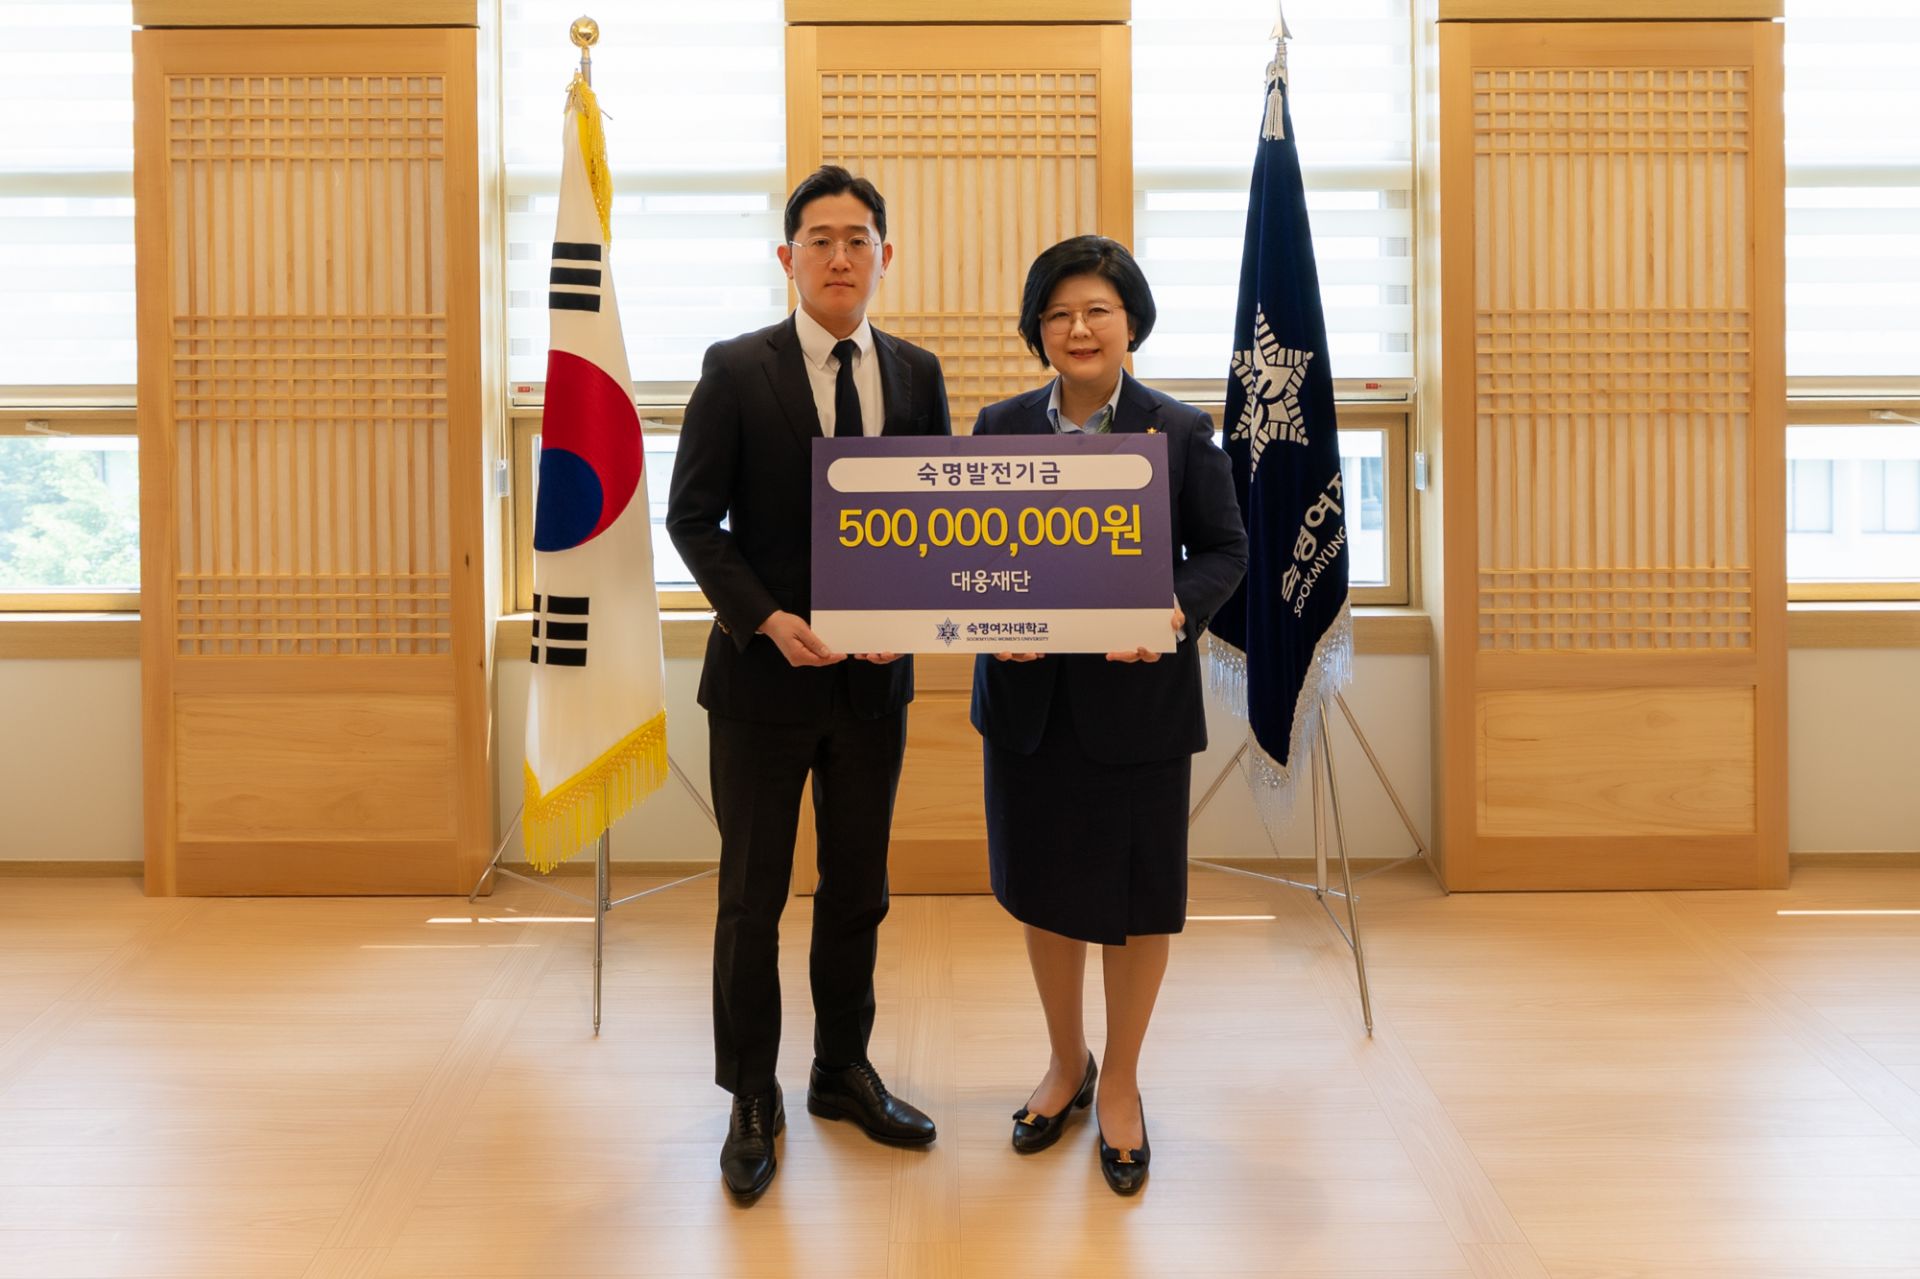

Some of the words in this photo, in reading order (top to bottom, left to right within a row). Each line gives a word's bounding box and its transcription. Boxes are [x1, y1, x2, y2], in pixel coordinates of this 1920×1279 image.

[917, 461, 1061, 487] 숙명발전기금
[839, 504, 1143, 558] 500,000,000원
[951, 570, 1032, 593] 대웅재단
[1294, 526, 1346, 618] SOOKMYUNG
[966, 622, 1049, 635] 숙명여자대학교
